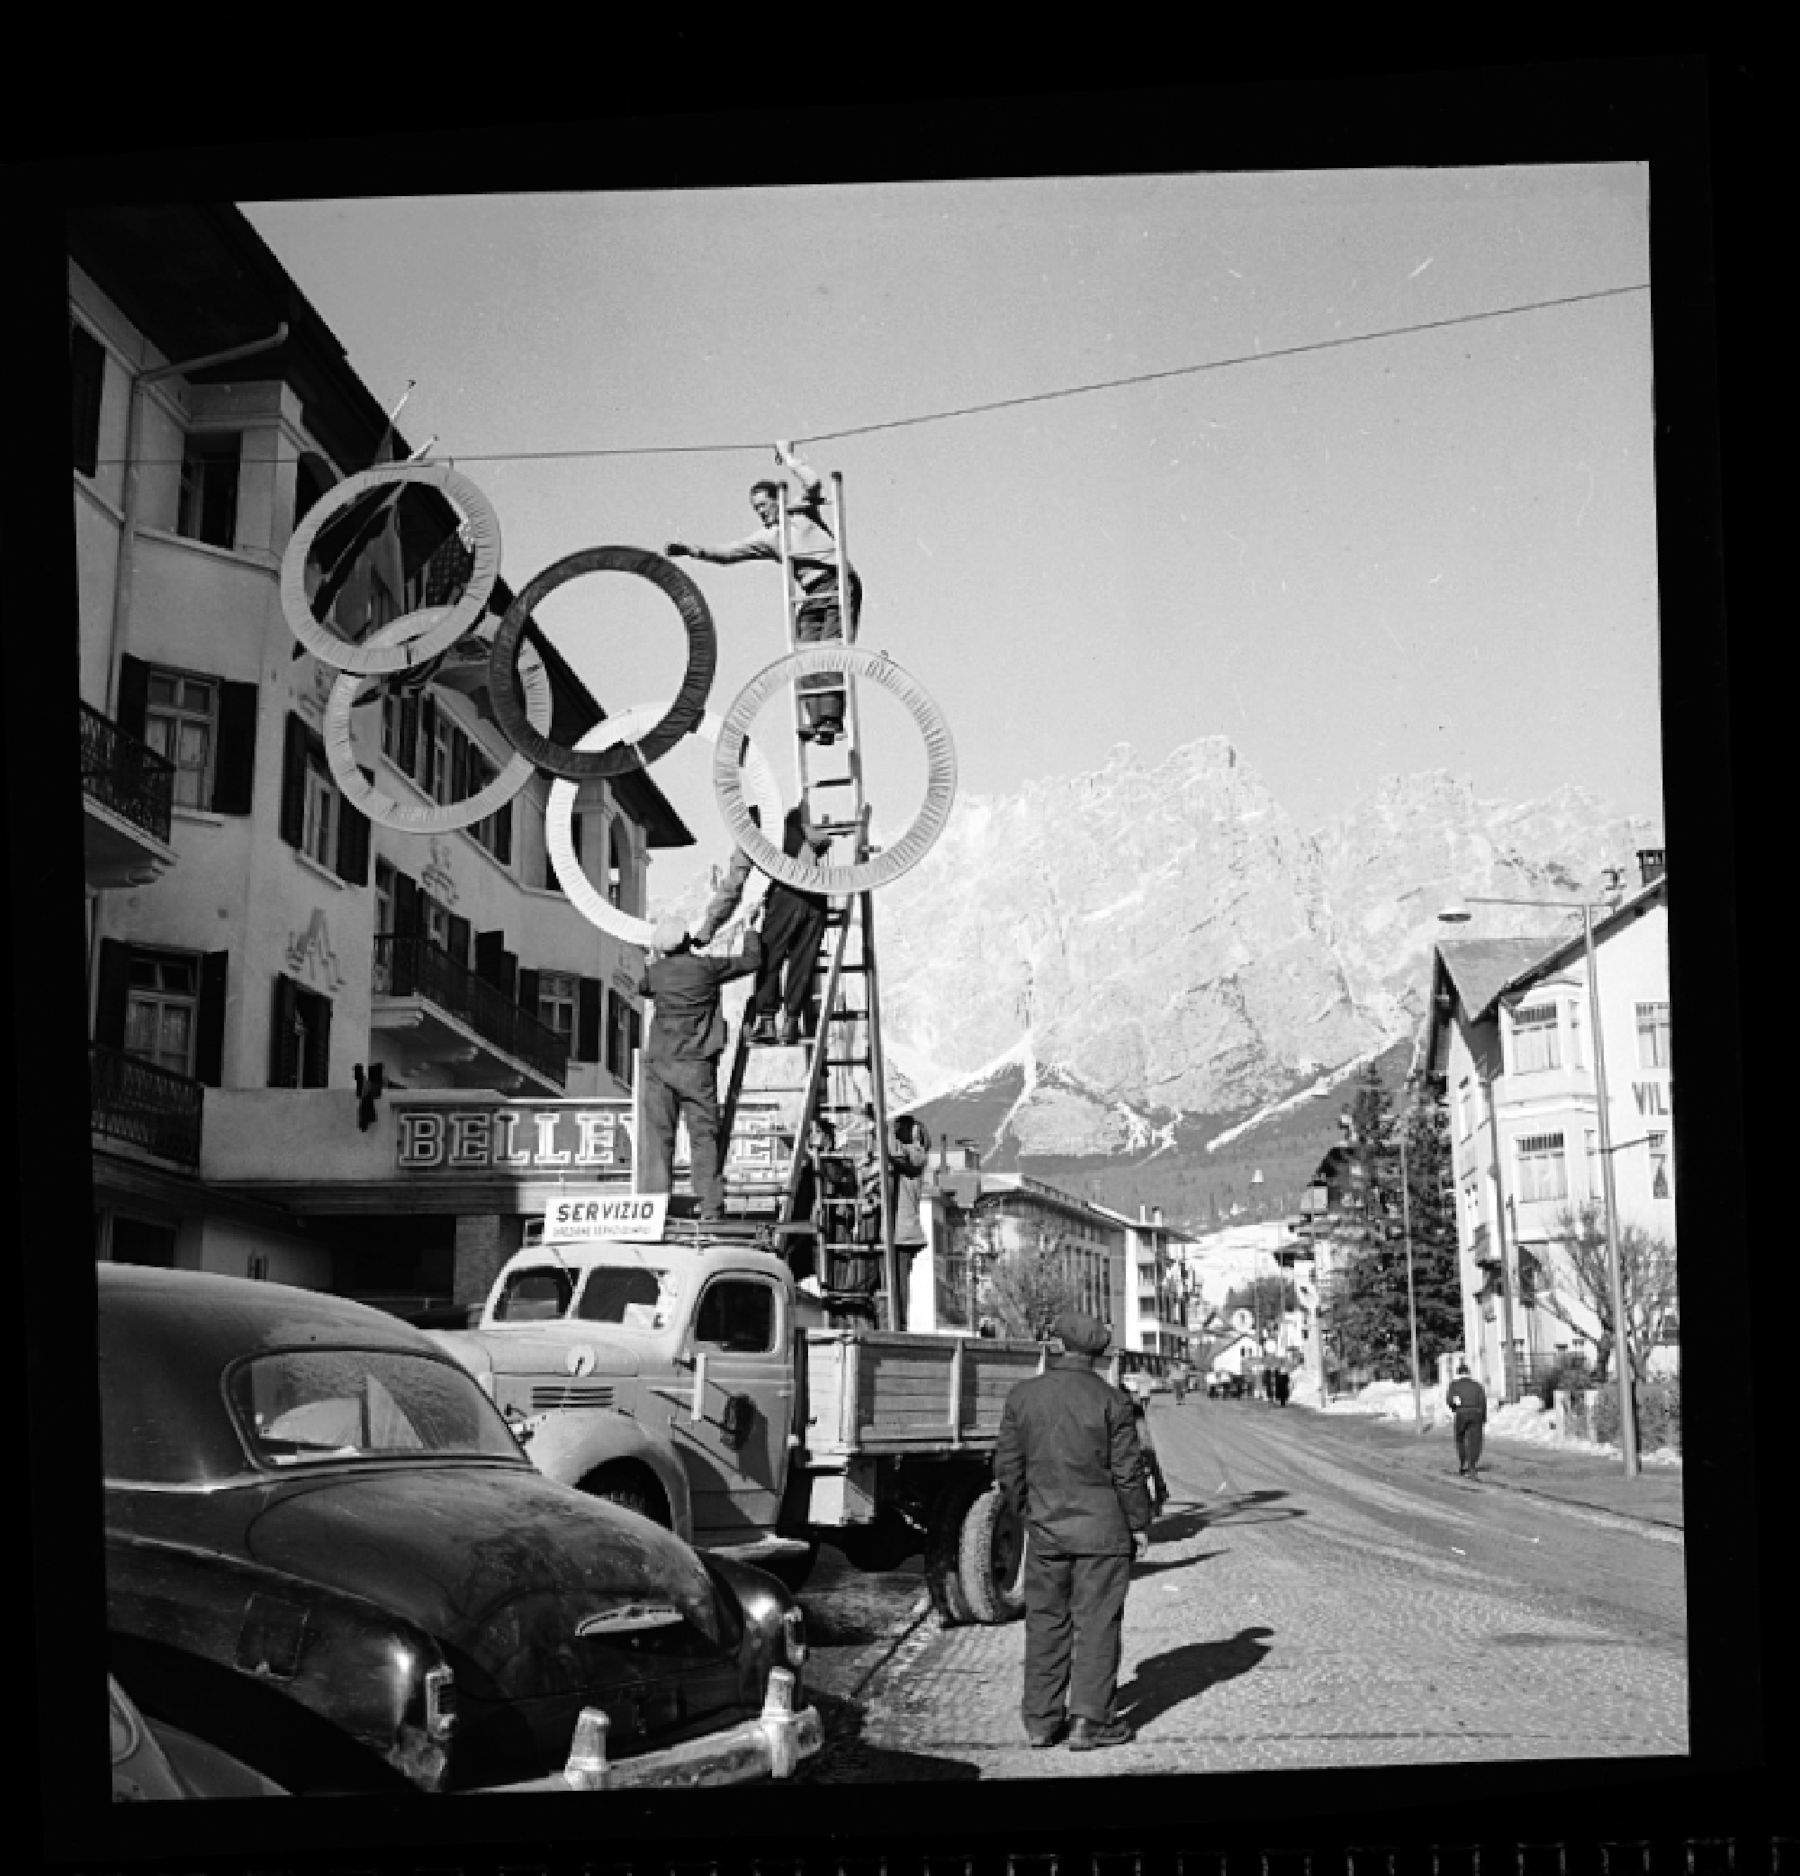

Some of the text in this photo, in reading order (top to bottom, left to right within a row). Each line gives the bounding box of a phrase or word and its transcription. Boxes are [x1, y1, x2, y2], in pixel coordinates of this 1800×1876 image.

[1631, 1081, 1671, 1116] VIL
[400, 1112, 772, 1166] BELLEE
[556, 1200, 654, 1222] SERVIZIO
